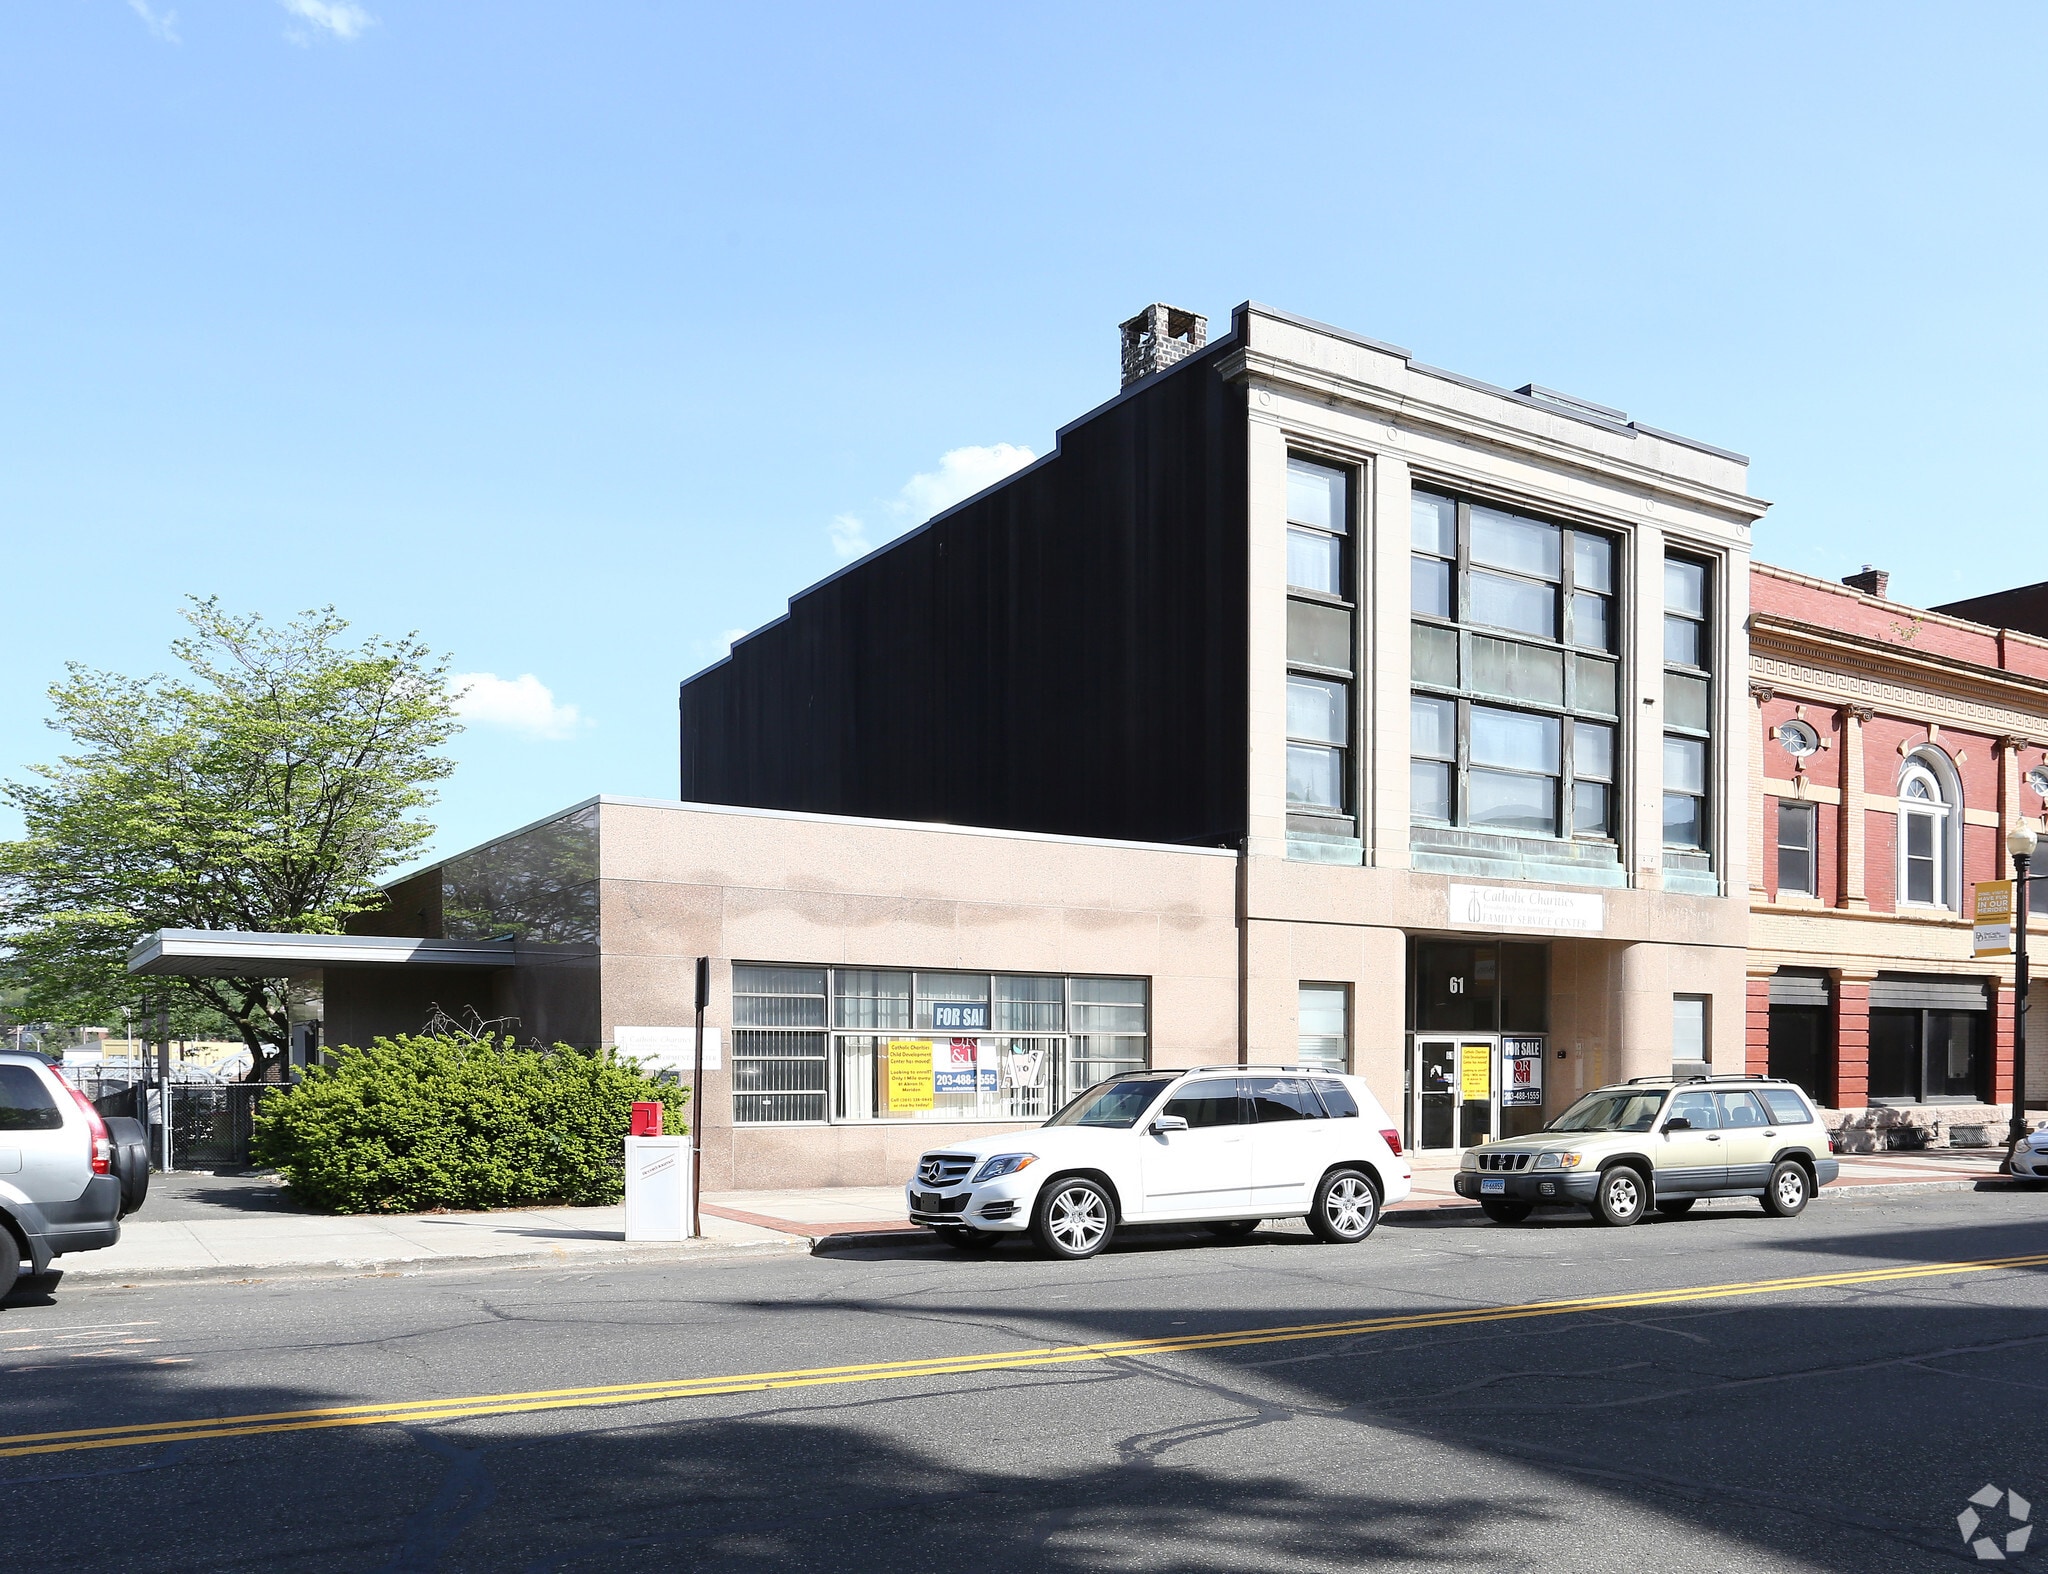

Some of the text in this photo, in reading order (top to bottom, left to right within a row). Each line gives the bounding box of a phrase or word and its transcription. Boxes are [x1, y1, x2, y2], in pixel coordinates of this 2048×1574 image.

[1483, 888, 1574, 907] Catholic Charities
[1990, 899, 2008, 907] OUR
[1483, 912, 1587, 929] FAMILY SERVICE CENTER
[1450, 976, 1464, 994] 61
[936, 1007, 984, 1026] FOR SAL
[1505, 1042, 1539, 1056] FOR SALE
[937, 1073, 995, 1086] 203-488-555
